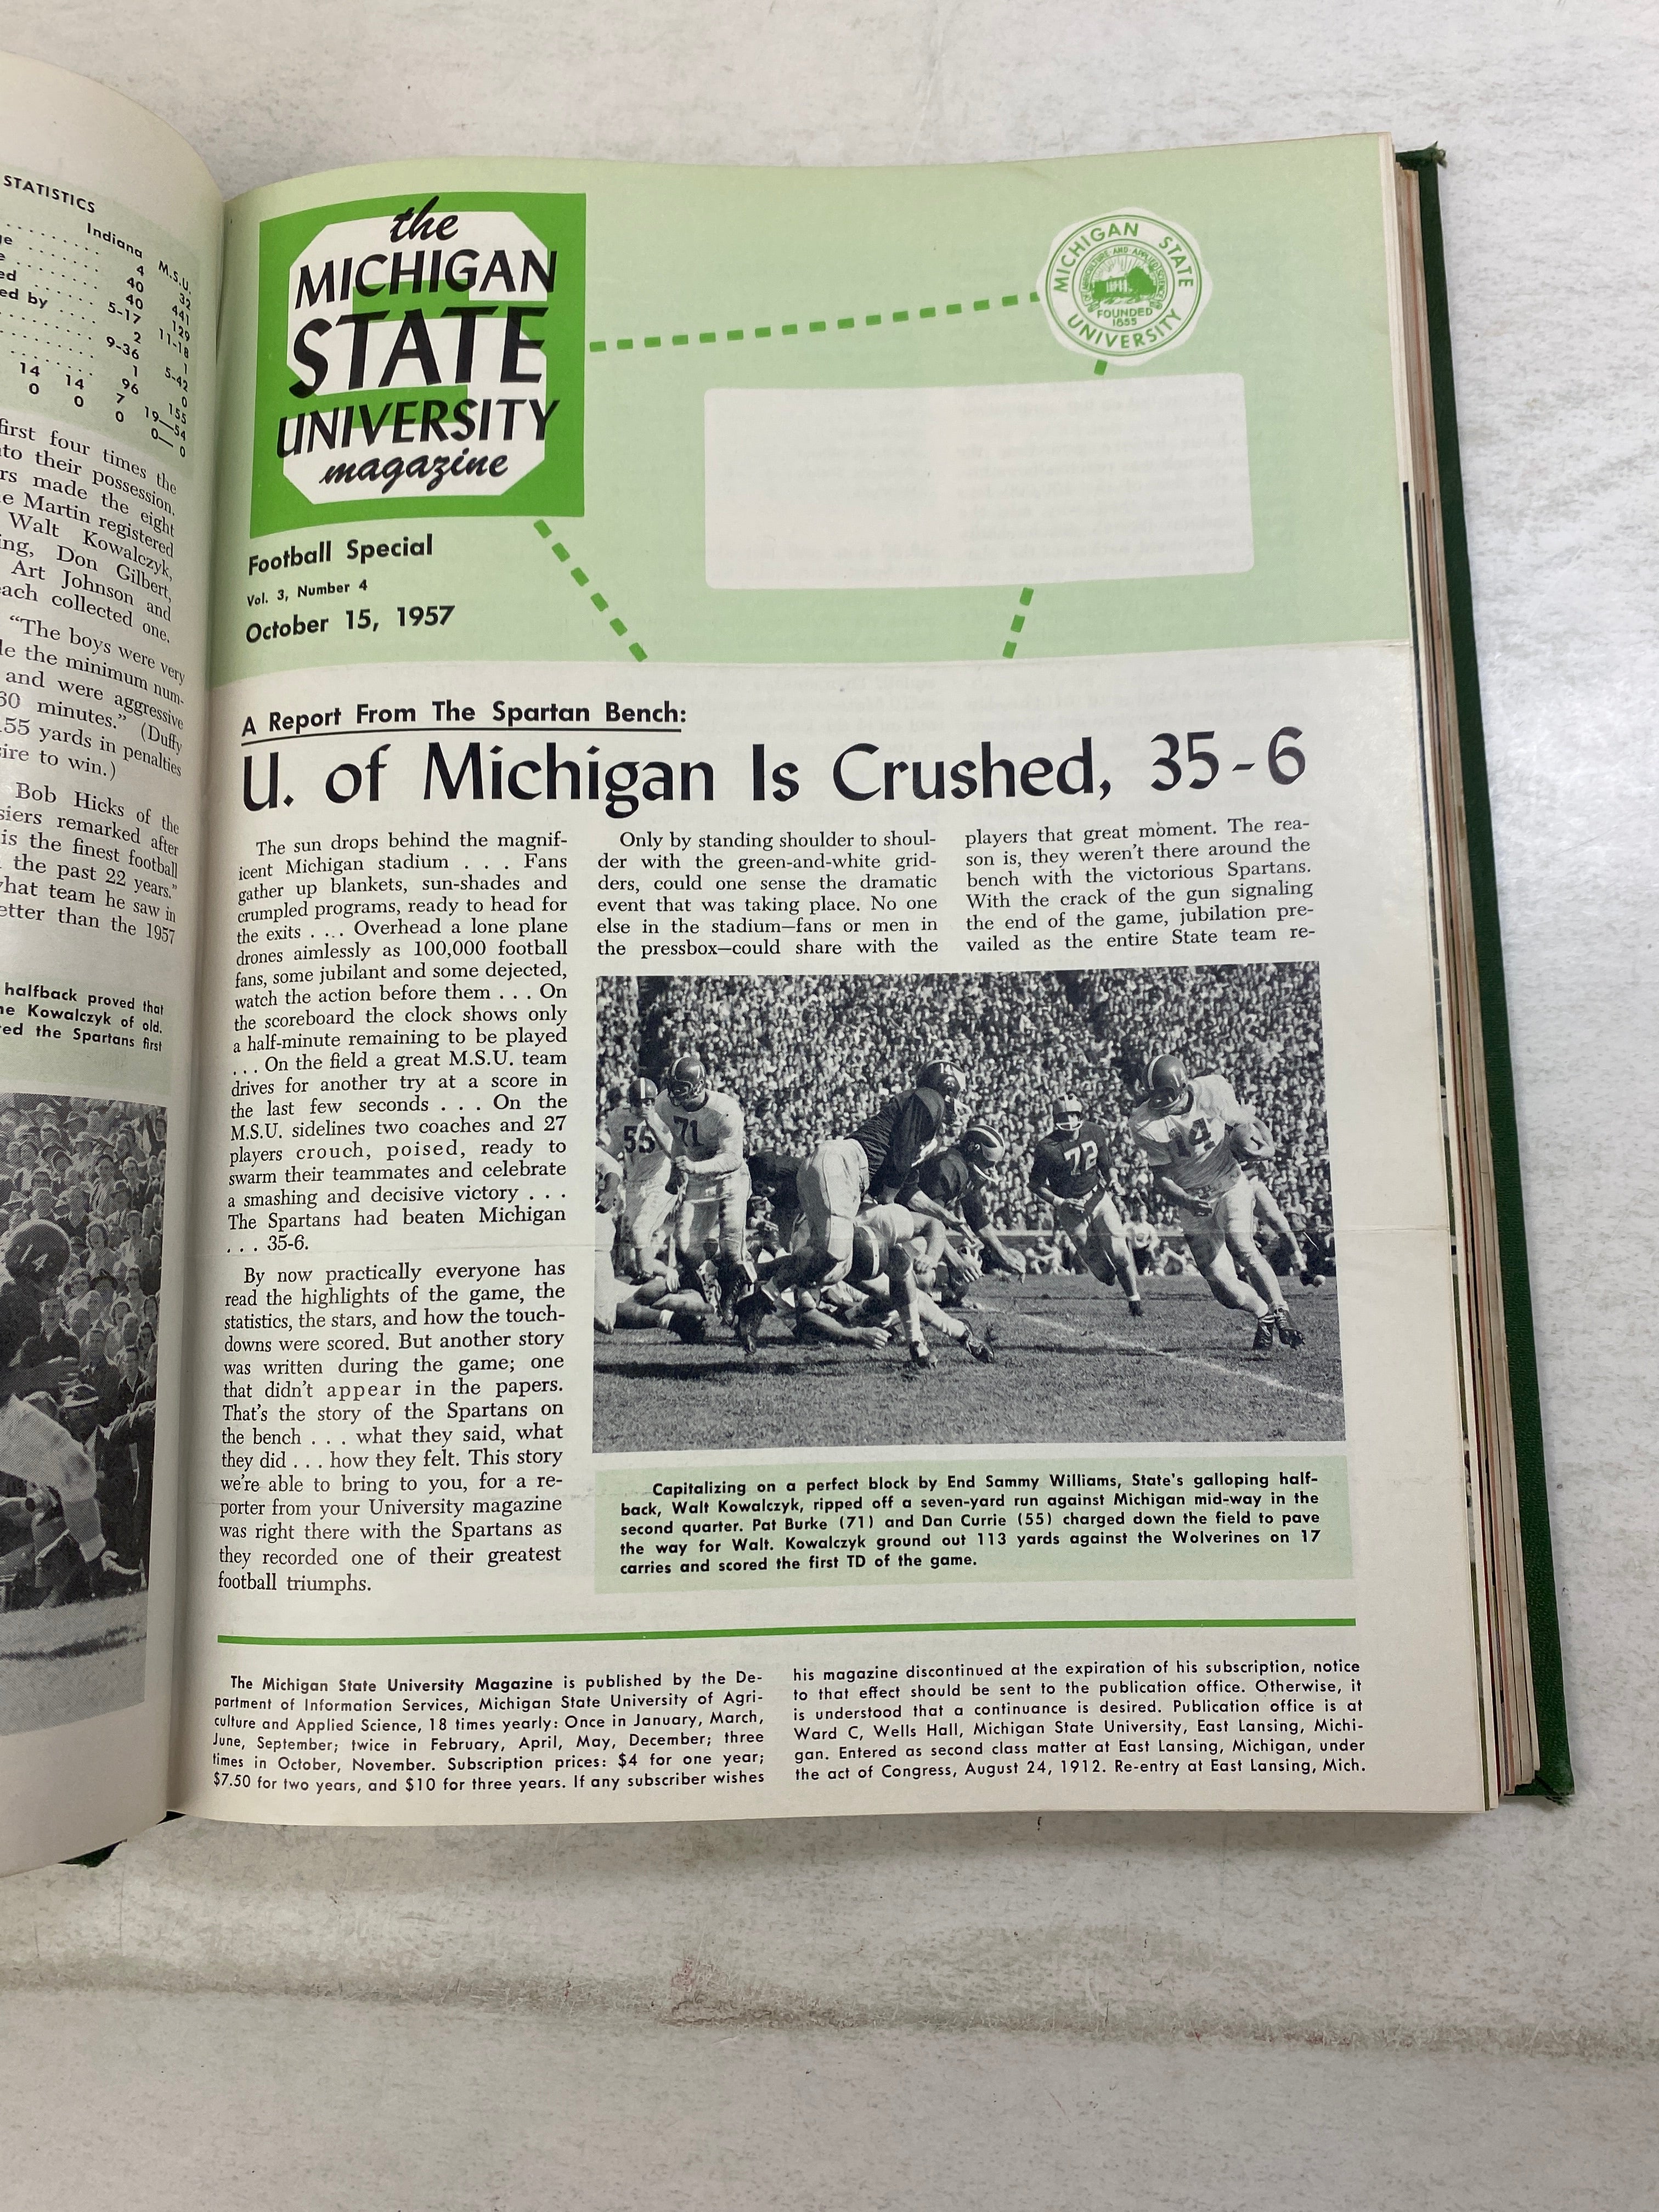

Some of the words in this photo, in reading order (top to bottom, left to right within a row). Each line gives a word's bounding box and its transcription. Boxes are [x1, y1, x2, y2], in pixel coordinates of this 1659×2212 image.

[3, 175, 95, 213] STATISTICS
[390, 195, 459, 242] the
[86, 222, 143, 259] Indiana
[157, 259, 192, 296] M.S.U.
[1053, 222, 1139, 293] MICHIGAN
[1158, 235, 1194, 287] STATE
[1113, 246, 1129, 255] AND
[1132, 247, 1159, 268] APPLIED
[1155, 269, 1166, 300] SCIENCE
[136, 265, 144, 276] 4
[178, 292, 192, 311] 32
[295, 248, 557, 309] MICHIGAN
[126, 277, 144, 293] 40
[171, 304, 190, 326] 441
[1097, 307, 1153, 319] FOUNDED
[108, 301, 142, 325] 5-17
[159, 327, 189, 359] 11-18
[1066, 308, 1182, 349] UNIVERSITY
[106, 336, 139, 360] 9-36
[165, 366, 189, 393] 5-42
[289, 305, 549, 399] STATE
[122, 378, 139, 395] 96
[168, 403, 187, 425] 155
[276, 398, 561, 459] UNIVERSITY
[0, 417, 36, 441] first
[49, 430, 91, 456] four
[103, 449, 146, 479] times
[156, 472, 177, 495] the
[318, 447, 509, 494] magazine
[8, 511, 59, 538] Walt
[82, 528, 172, 582] Kowalczyk,
[249, 540, 331, 576] Football
[346, 533, 433, 565] Special
[10, 560, 46, 580] Art
[61, 569, 134, 606] Johnson
[146, 602, 171, 622] and
[246, 592, 268, 607] Vol.
[276, 589, 289, 602] 3,
[297, 582, 350, 598] Number
[358, 579, 368, 591] 4
[246, 613, 329, 644] October
[346, 608, 379, 632] 15,
[397, 605, 455, 627] 1957
[241, 716, 257, 737] A
[269, 707, 342, 735] Report
[357, 703, 416, 724] From
[432, 699, 476, 721] The
[492, 700, 590, 727] Spartan
[606, 700, 686, 723] Bench:
[243, 751, 294, 812] U.
[325, 743, 391, 804] of
[423, 742, 714, 819] Michigan
[752, 743, 799, 802] Is
[833, 736, 1111, 802] Crushed,
[256, 839, 286, 856] The
[294, 840, 322, 853] sun
[331, 833, 379, 853] drops
[388, 831, 450, 848] behind
[459, 831, 488, 847] the
[497, 830, 567, 851] magnif-
[619, 831, 663, 851] Only
[669, 831, 692, 851] by
[698, 831, 774, 851] standing
[780, 831, 854, 848] shoulder
[860, 834, 877, 847] to
[883, 829, 936, 847] shoul-
[965, 892, 1011, 909] With
[1020, 891, 1049, 907] the
[1060, 888, 1108, 906] crack
[1118, 887, 1136, 904] of
[1146, 886, 1175, 902] the
[1186, 889, 1221, 905] gun
[1232, 879, 1313, 901] signaling
[236, 950, 283, 966] drones
[294, 941, 371, 962] aimlessly
[382, 946, 400, 957] as
[414, 940, 487, 959] 100,000
[498, 939, 568, 956] football
[4, 981, 77, 1002] halfback
[88, 994, 135, 1010] proved
[143, 1000, 164, 1015] that
[230, 1122, 282, 1141] M.S.U.
[292, 1119, 365, 1138] sidelines
[375, 1121, 409, 1135] two
[419, 1116, 490, 1134] coaches
[500, 1115, 535, 1132] and
[544, 1114, 567, 1131] 27
[623, 1125, 656, 1153] 55
[673, 1115, 704, 1147] 71
[1168, 1116, 1216, 1158] 14
[1063, 1139, 1098, 1176] 72
[244, 1267, 265, 1288] By
[277, 1269, 313, 1283] now
[325, 1262, 422, 1286] practically
[436, 1266, 521, 1282] everyone
[534, 1259, 565, 1276] has
[652, 1481, 746, 1499] Capitalizing
[757, 1483, 776, 1493] on
[786, 1482, 796, 1492] a
[806, 1477, 859, 1495] perfect
[868, 1475, 909, 1490] block
[918, 1475, 938, 1492] by
[947, 1475, 975, 1488] End
[985, 1474, 1040, 1491] Sammy
[1049, 1473, 1122, 1489] Williams,
[1132, 1472, 1183, 1487] State's
[1193, 1472, 1269, 1489] galloping
[1279, 1471, 1318, 1485] half-
[218, 1570, 277, 1590] football
[286, 1573, 371, 1596] triumphs.
[620, 1560, 672, 1575] carries
[680, 1558, 710, 1573] and
[718, 1556, 768, 1572] scored
[776, 1555, 800, 1570] the
[809, 1555, 839, 1569] first
[846, 1554, 866, 1568] TD
[874, 1553, 890, 1567] of
[898, 1553, 922, 1567] the
[930, 1556, 977, 1570] game.
[230, 1675, 253, 1690] The
[262, 1677, 328, 1695] Michigan
[338, 1678, 376, 1692] State
[387, 1678, 465, 1694] University
[475, 1676, 553, 1694] Magazine
[563, 1675, 575, 1689] is
[585, 1673, 662, 1691] published
[673, 1672, 691, 1689] by
[702, 1671, 726, 1685] the
[736, 1670, 762, 1684] De-
[793, 1726, 837, 1740] Ward
[848, 1725, 864, 1741] C,
[873, 1724, 917, 1738] Wells
[927, 1722, 963, 1738] Hall,
[973, 1721, 1045, 1737] Michigan
[1054, 1720, 1094, 1734] State
[1104, 1719, 1187, 1736] University,
[1198, 1719, 1229, 1733] East
[1239, 1718, 1305, 1735] Lansing,
[1314, 1718, 1363, 1732] Michi-
[213, 1771, 251, 1788] $7.50
[257, 1775, 277, 1790] for
[283, 1778, 309, 1791] two
[315, 1781, 361, 1795] years,
[368, 1778, 397, 1792] and
[405, 1776, 436, 1792] $10
[443, 1777, 465, 1791] for
[472, 1777, 512, 1790] three
[518, 1779, 566, 1793] years.
[574, 1774, 585, 1788] If
[591, 1778, 620, 1791] any
[627, 1771, 707, 1787] subscriber
[713, 1770, 764, 1784] wishes
